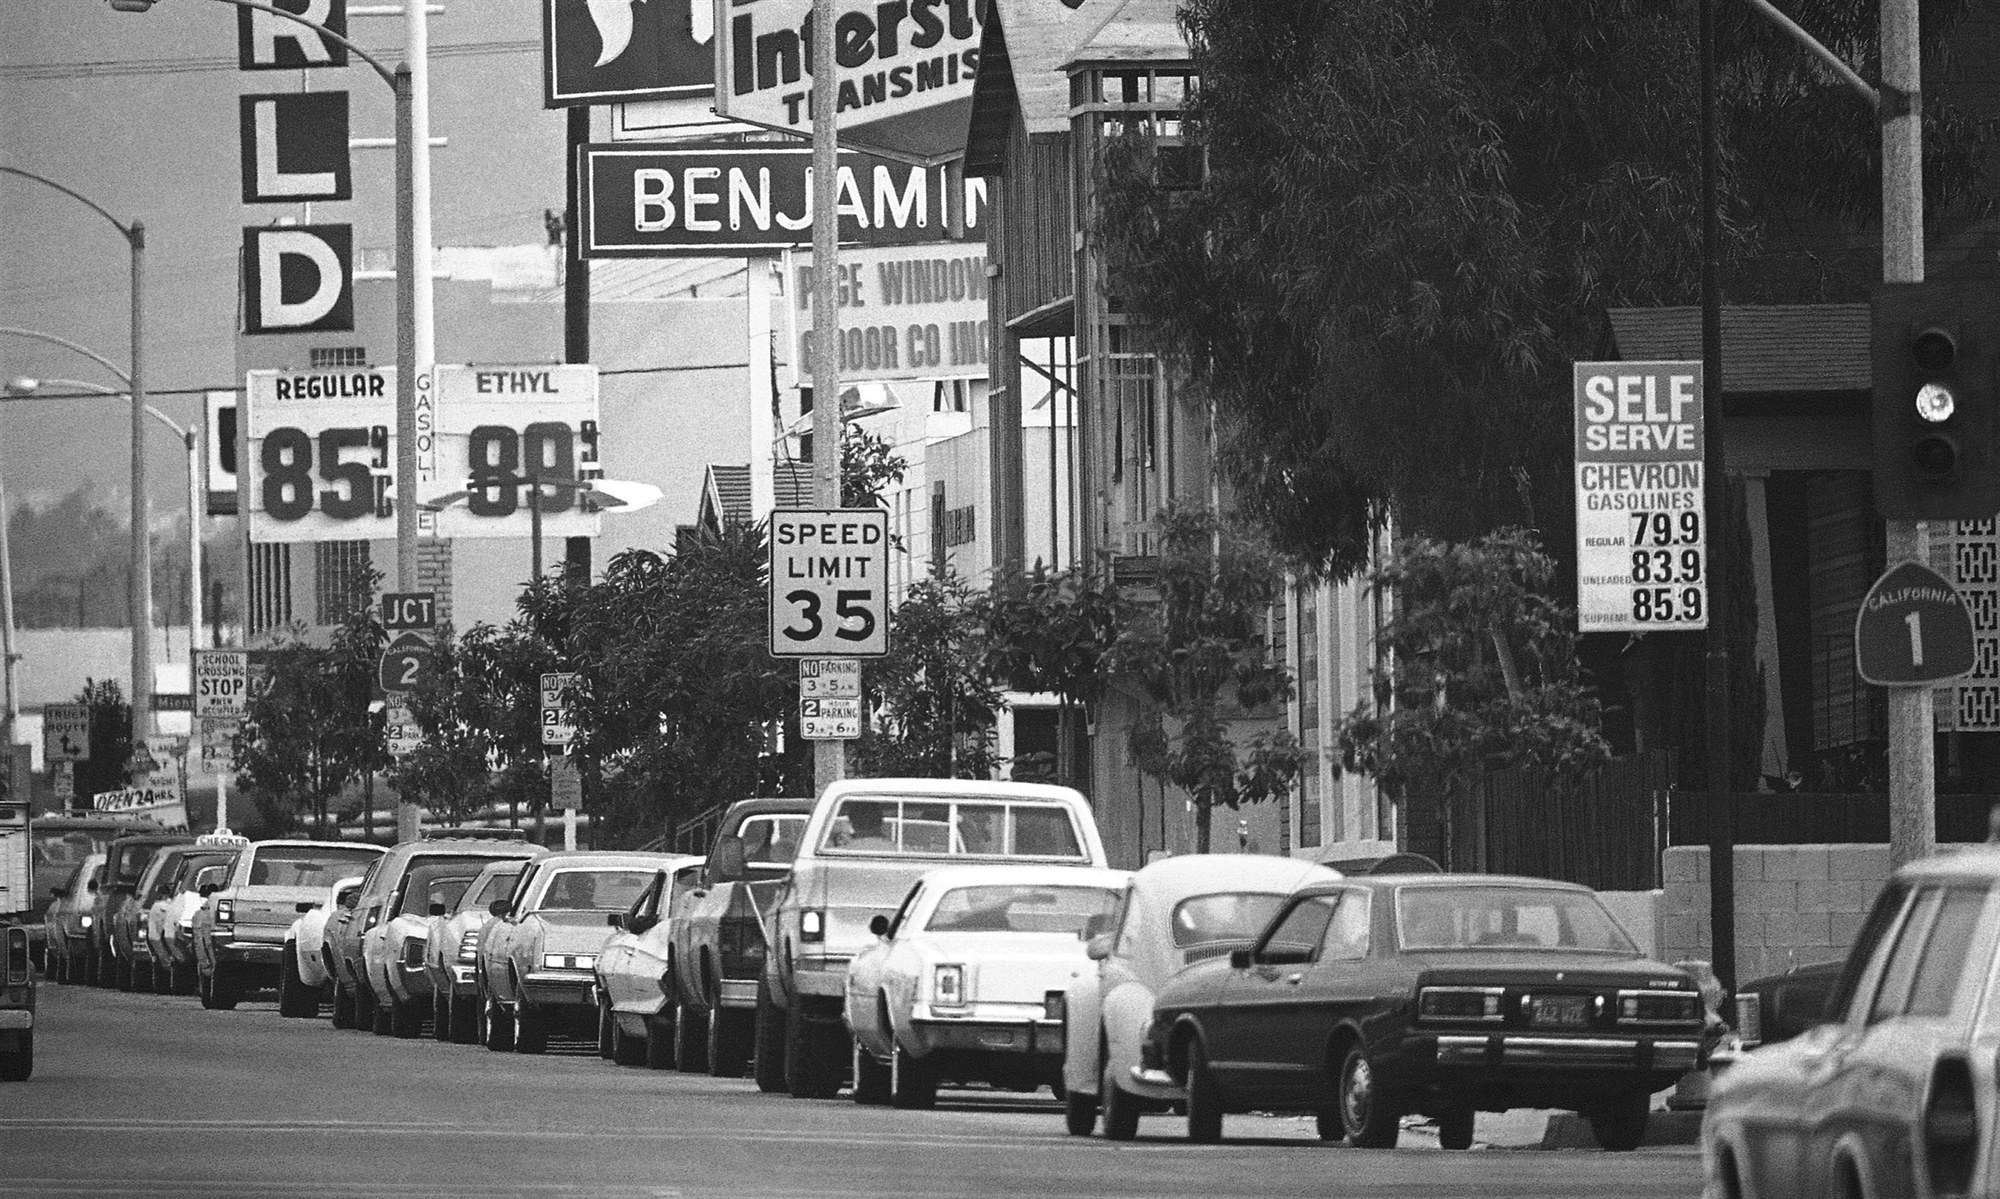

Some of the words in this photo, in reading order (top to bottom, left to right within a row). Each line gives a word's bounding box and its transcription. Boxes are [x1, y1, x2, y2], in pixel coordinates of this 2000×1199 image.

[783, 48, 980, 124] TANSMIS
[799, 263, 864, 310] PGE
[907, 323, 940, 367] CO
[277, 374, 385, 400] REGULAR
[476, 371, 559, 393] ETHYL
[1585, 375, 1694, 423] SELF
[1586, 424, 1695, 451] SERVE
[262, 426, 375, 521] 85
[468, 421, 575, 517] 89
[1581, 464, 1699, 491] CHEVRON
[1587, 492, 1694, 511] GASOLINES
[778, 523, 880, 545] SPEED
[1585, 537, 1625, 546] REGULAR
[1632, 511, 1699, 545] 79.9
[788, 557, 871, 578] LIMIT
[1583, 576, 1631, 585] UNLEADED
[1632, 549, 1700, 583] 83.9
[1584, 614, 1628, 622] SUPREME
[1633, 588, 1701, 622] 85.9
[1868, 587, 1957, 611] CALIFORNIA
[387, 598, 431, 624] JCT
[782, 589, 875, 642] 35
[1905, 611, 1923, 666] 1
[202, 655, 239, 665] SCHOOL
[401, 656, 419, 684] 2
[803, 661, 818, 676] NO
[821, 662, 857, 673] PARKING
[198, 666, 245, 677] CROSSING
[544, 676, 557, 689] NO
[200, 678, 243, 695] STOP
[808, 680, 816, 691] 3
[829, 680, 838, 691] 5
[546, 711, 556, 724] 2
[805, 701, 817, 716] 2
[821, 707, 858, 719] PARKING
[390, 726, 400, 738] 2
[547, 730, 554, 740] 9
[806, 722, 814, 734] 9
[837, 723, 845, 732] 6
[96, 791, 134, 810] OPEN
[134, 789, 154, 805] 24
[199, 836, 248, 847] CHECKER
